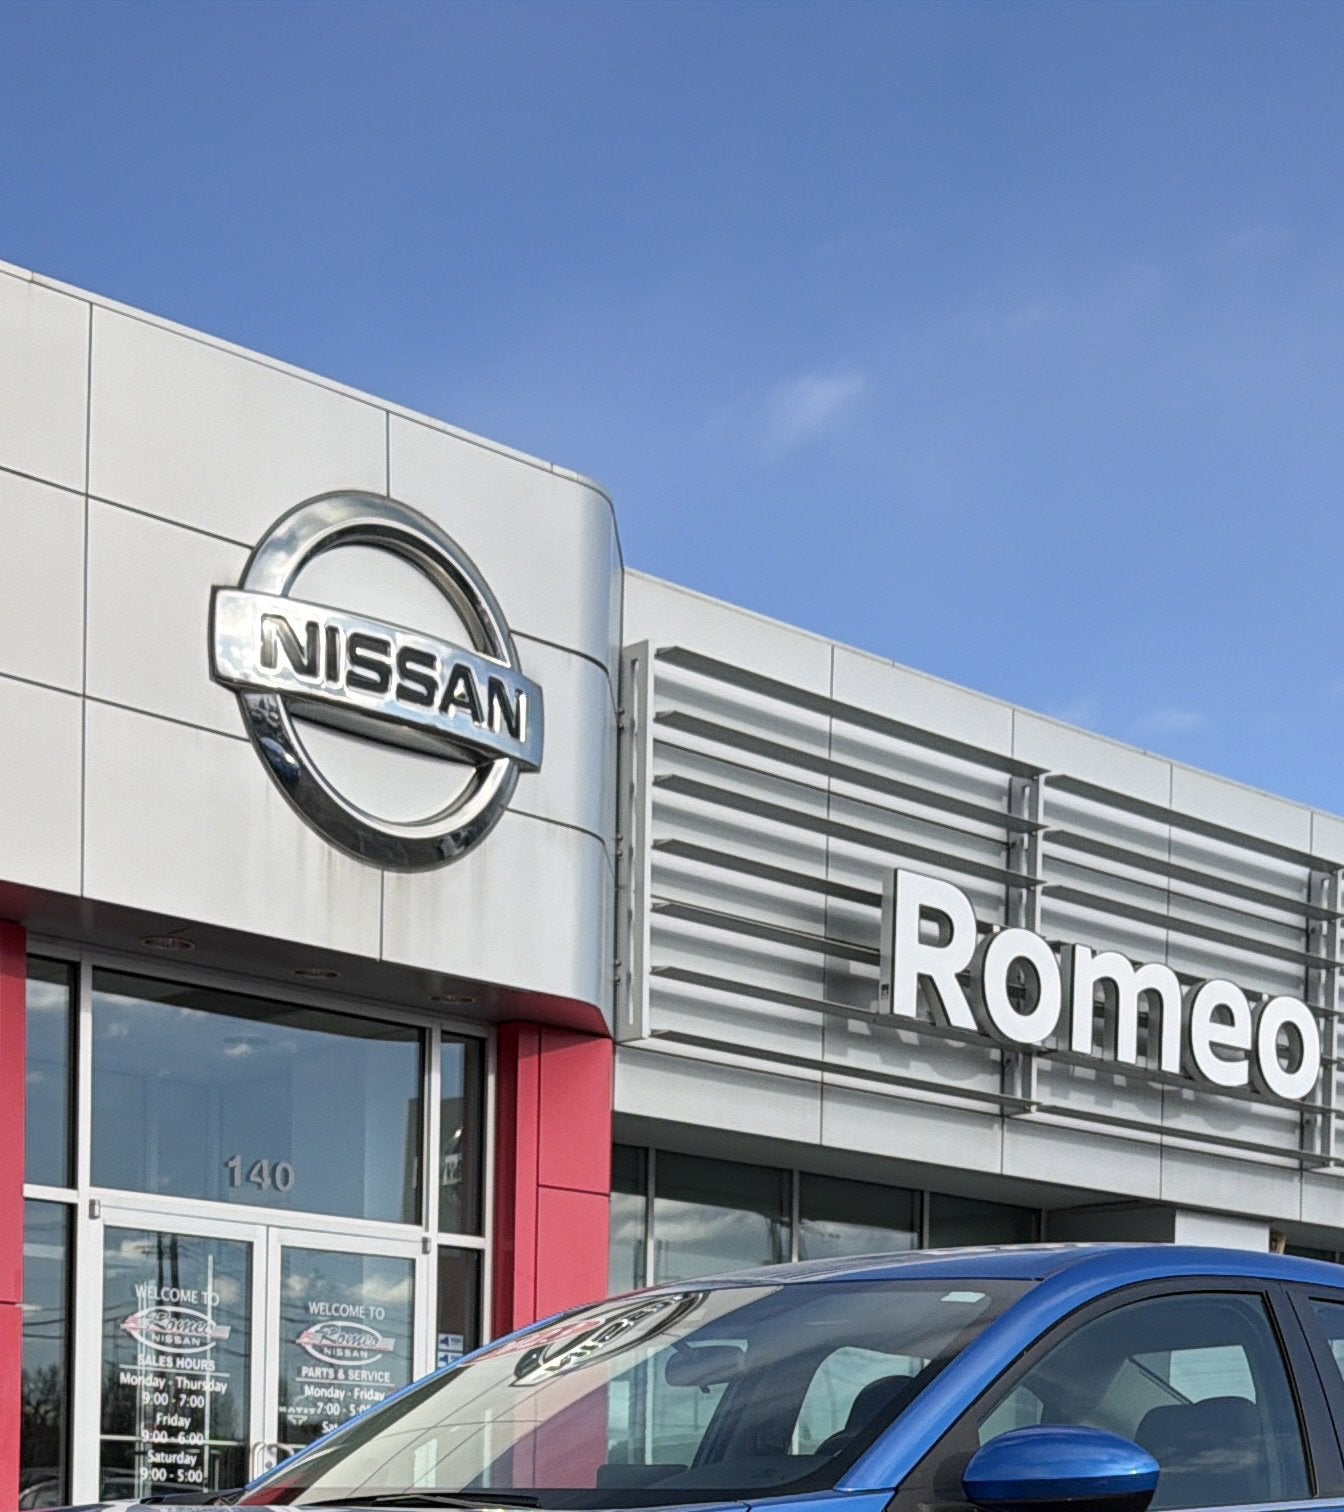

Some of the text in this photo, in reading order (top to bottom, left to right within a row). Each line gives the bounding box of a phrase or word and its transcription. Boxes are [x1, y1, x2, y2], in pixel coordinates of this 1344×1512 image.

[260, 613, 527, 743] NISSAN
[884, 867, 1323, 1101] Romeo
[225, 1154, 296, 1192] 140
[134, 1284, 220, 1306] WELCOME TO
[308, 1301, 386, 1321] WELCOME TO
[137, 1353, 216, 1371] SALES HOURS
[119, 1372, 167, 1391] Monday
[175, 1376, 228, 1394] Thursday
[301, 1366, 391, 1383] PARTS & SERVICE
[142, 1391, 169, 1406] 9:00
[179, 1394, 205, 1408] 7:00
[304, 1384, 346, 1401] Monday
[353, 1387, 386, 1401] Friday
[316, 1401, 341, 1416] 7:00
[156, 1412, 192, 1430] Friday
[141, 1429, 168, 1443] 9:00
[177, 1431, 205, 1445] 6:00
[147, 1449, 198, 1467] Saturday
[139, 1468, 167, 1482] 9:00
[177, 1469, 203, 1483] 5:00
